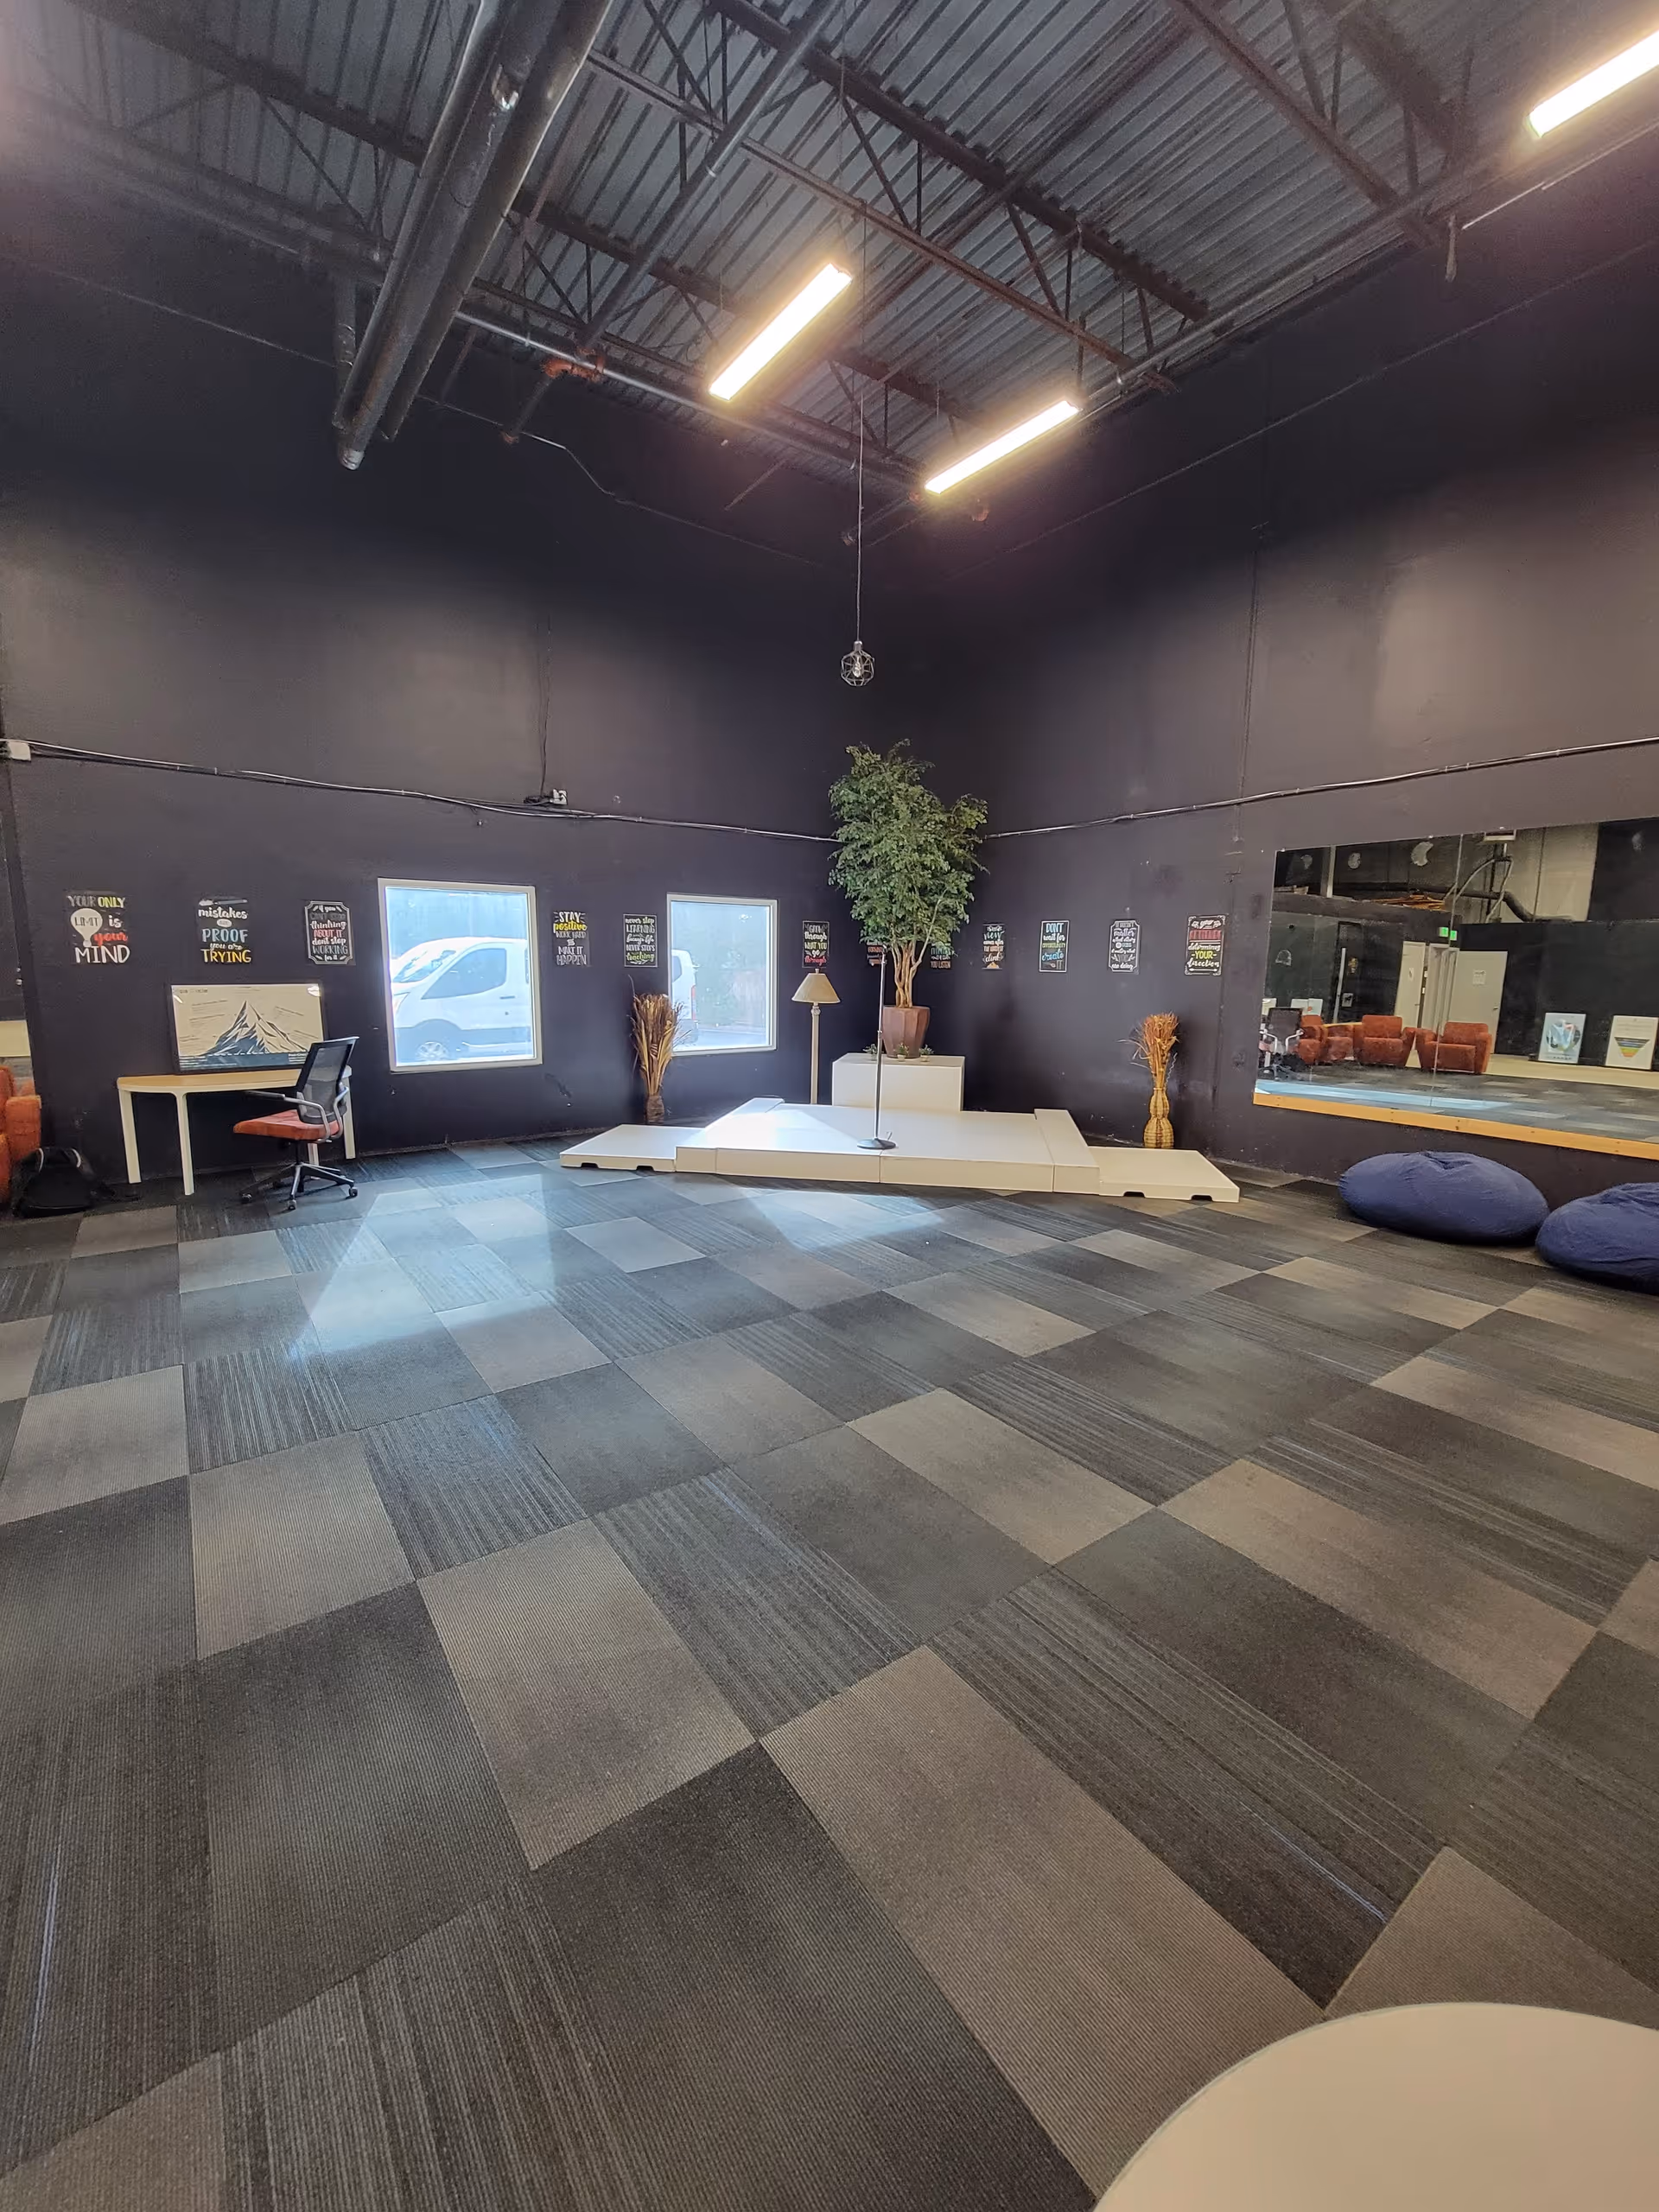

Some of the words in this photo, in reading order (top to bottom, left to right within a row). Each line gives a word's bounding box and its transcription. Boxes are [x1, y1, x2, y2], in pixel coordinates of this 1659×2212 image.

[67, 895, 97, 907] YOUR
[98, 896, 126, 908] ONLY
[198, 906, 248, 919] mistakes
[559, 911, 582, 923] STAY
[75, 917, 99, 926] LIMIT
[108, 915, 123, 928] is
[310, 919, 346, 930] thinking
[553, 920, 588, 933] positive
[93, 931, 128, 947] your
[201, 928, 248, 943] PROOF
[313, 929, 334, 938] ABOUT
[335, 929, 343, 938] IT
[330, 936, 346, 946] stop
[74, 944, 130, 963] MIND
[200, 949, 251, 963] TRYING
[312, 945, 348, 955] WORKING
[576, 946, 583, 955] IT
[556, 954, 587, 965] HAPPEN
[1186, 957, 1220, 968] direction
